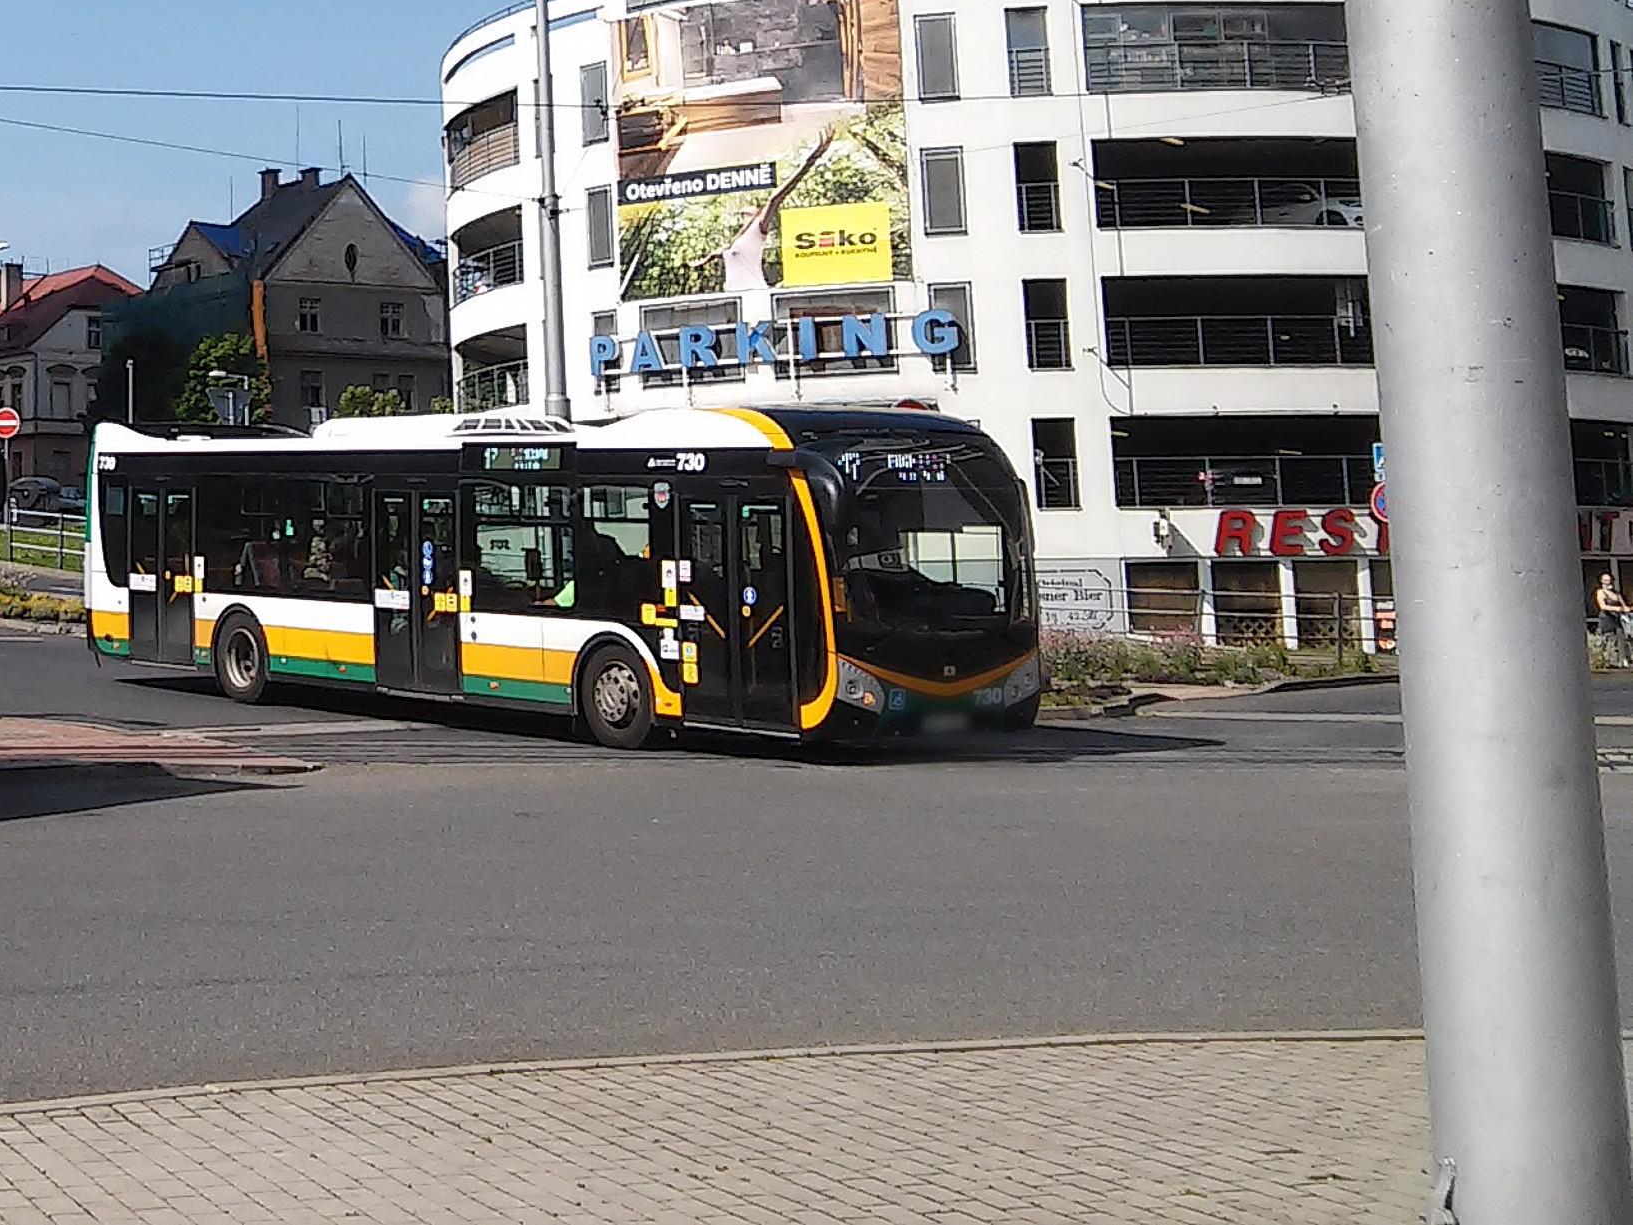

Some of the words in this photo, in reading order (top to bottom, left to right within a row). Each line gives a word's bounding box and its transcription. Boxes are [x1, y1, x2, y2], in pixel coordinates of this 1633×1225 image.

[625, 178, 704, 201] Otevřeno
[705, 164, 773, 191] DENNĚ
[589, 308, 961, 376] PARKING
[675, 452, 706, 471] 730
[972, 686, 1003, 707] 730
